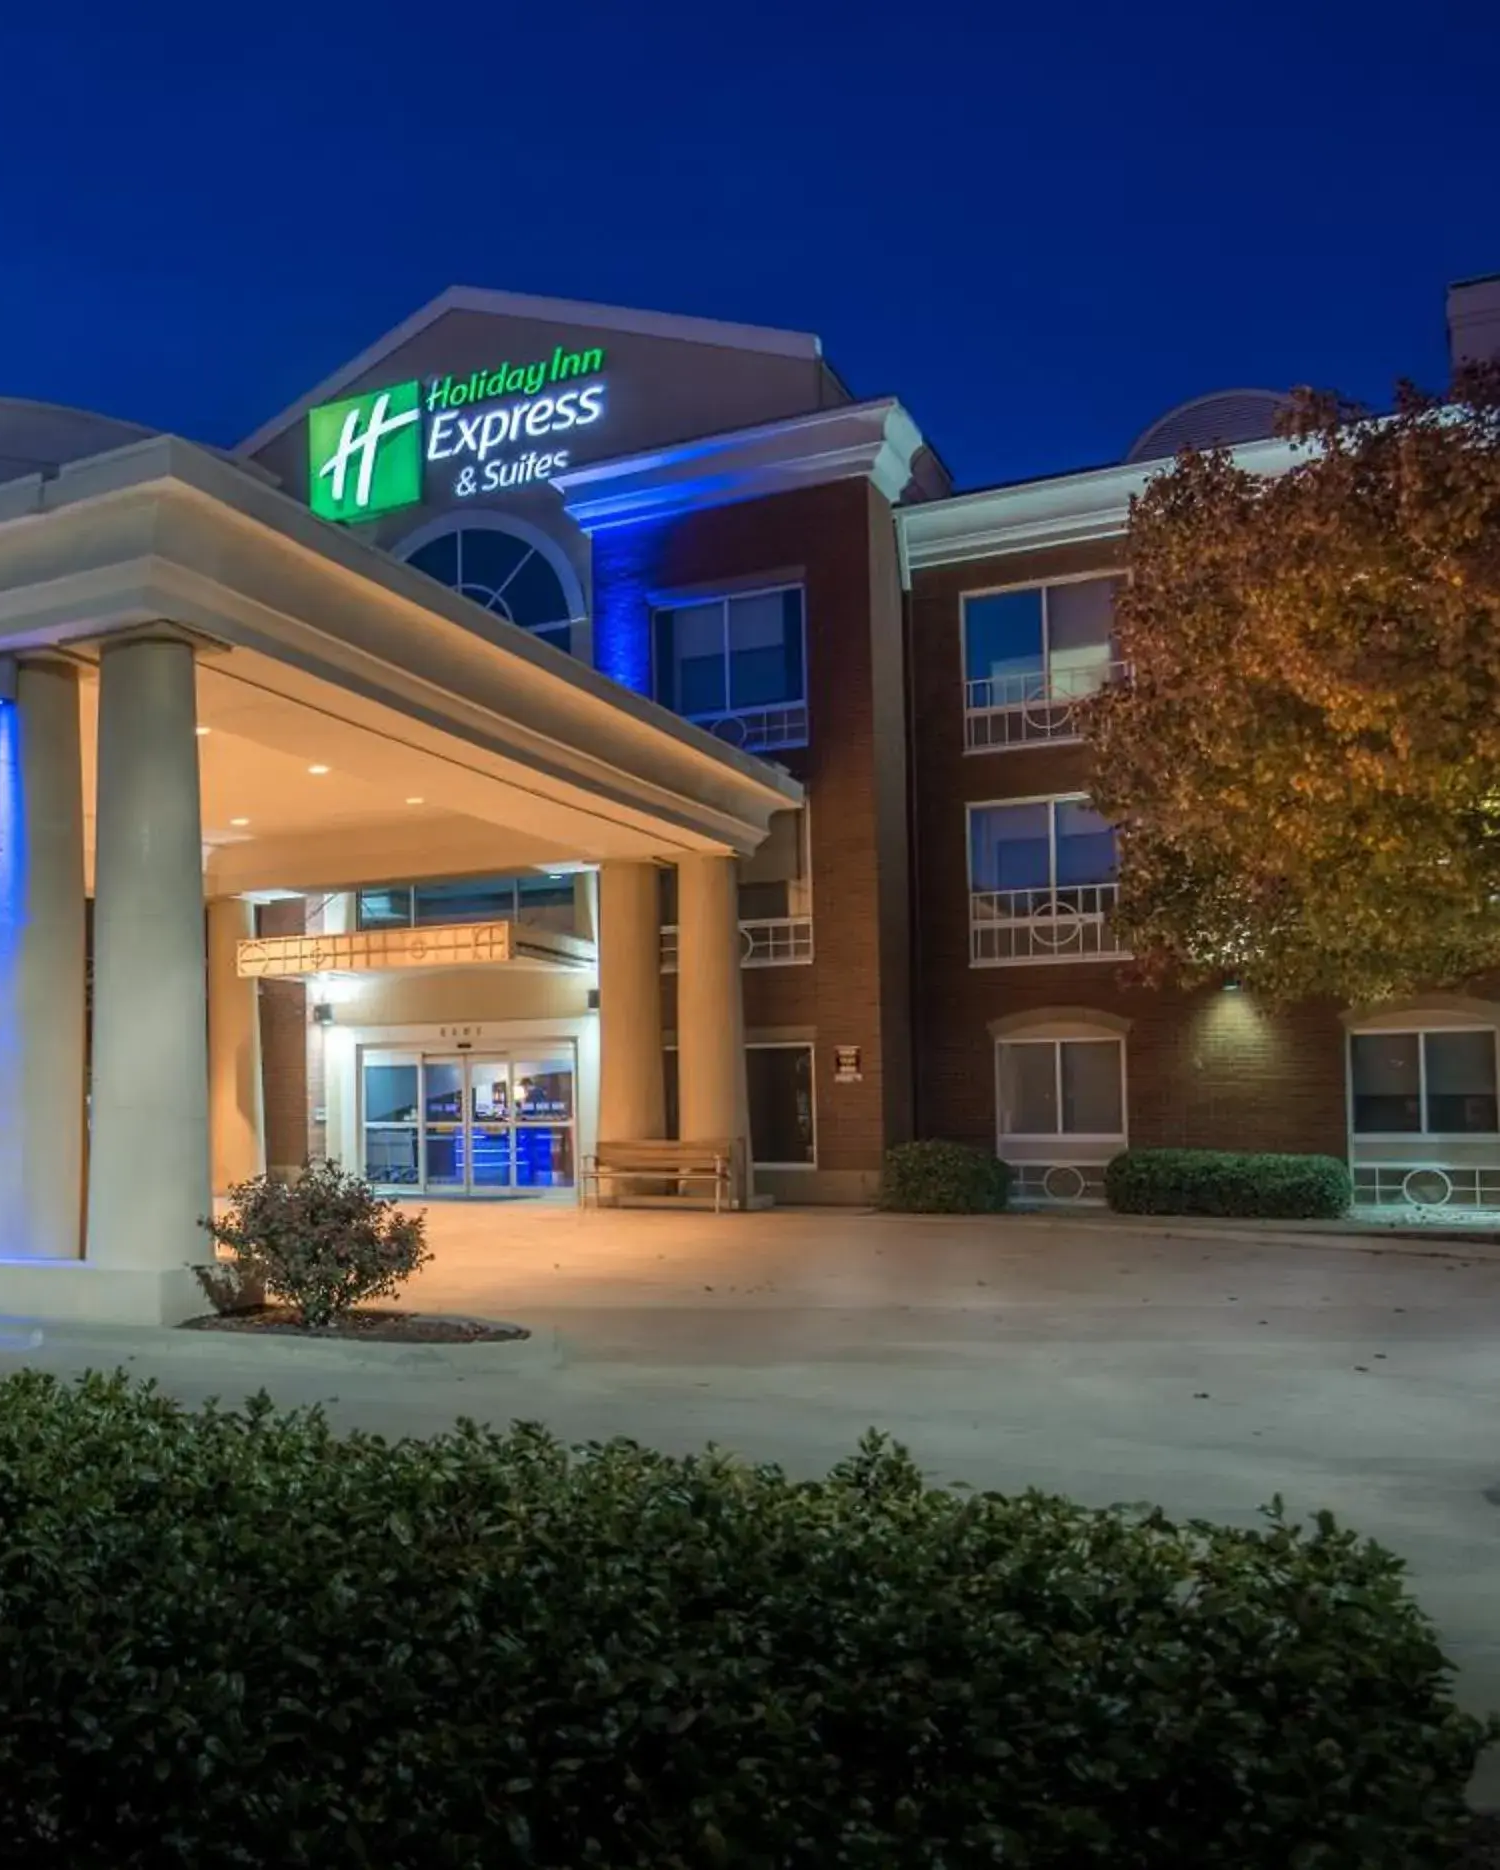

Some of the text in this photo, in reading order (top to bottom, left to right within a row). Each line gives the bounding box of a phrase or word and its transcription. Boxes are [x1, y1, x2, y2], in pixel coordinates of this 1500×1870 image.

[426, 346, 602, 412] Holiday Inn
[319, 394, 420, 506] H
[427, 385, 605, 461] Express
[455, 466, 477, 496] &
